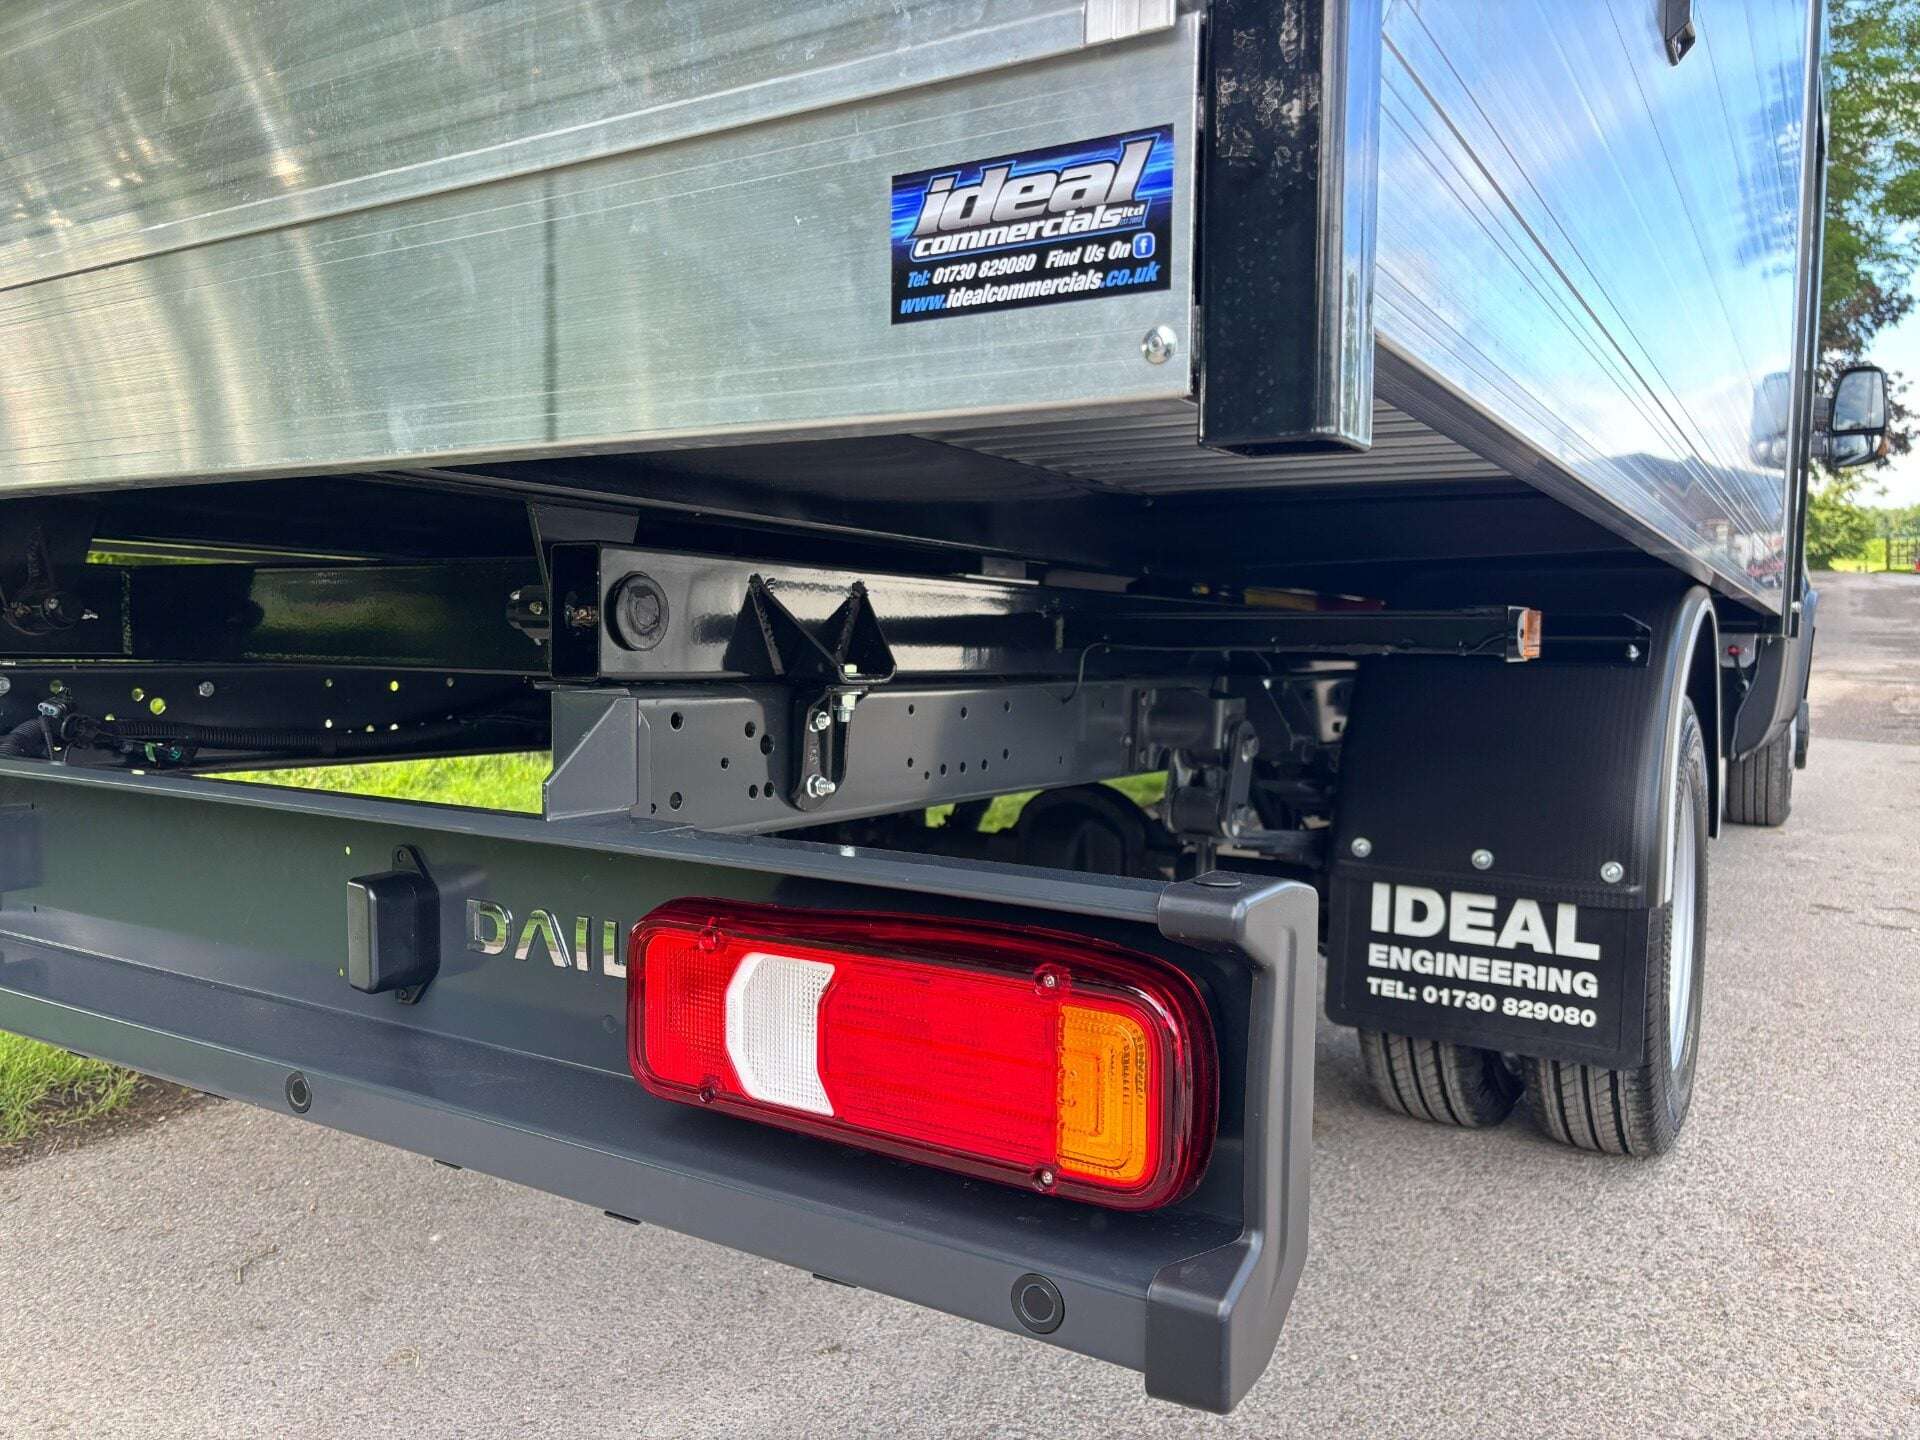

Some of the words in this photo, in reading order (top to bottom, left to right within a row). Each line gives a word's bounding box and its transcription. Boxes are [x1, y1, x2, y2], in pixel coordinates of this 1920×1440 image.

[912, 138, 1153, 235] ideal
[915, 203, 1122, 257] commercials
[1122, 204, 1145, 217] ltd
[901, 260, 1160, 314] www.idealcommercials.co.uk
[909, 270, 930, 288] Tel:
[933, 261, 976, 284] 01730
[979, 253, 1037, 278] 829080
[1046, 246, 1082, 268] Find
[1084, 243, 1105, 263] Us
[1109, 240, 1131, 259] On
[466, 898, 626, 978] DAIL
[1371, 881, 1600, 960] IDEAL
[1368, 942, 1598, 998] ENGINEERING
[1367, 976, 1415, 999] TEL:
[1423, 985, 1496, 1012] 01730
[1503, 997, 1597, 1027] 829080
